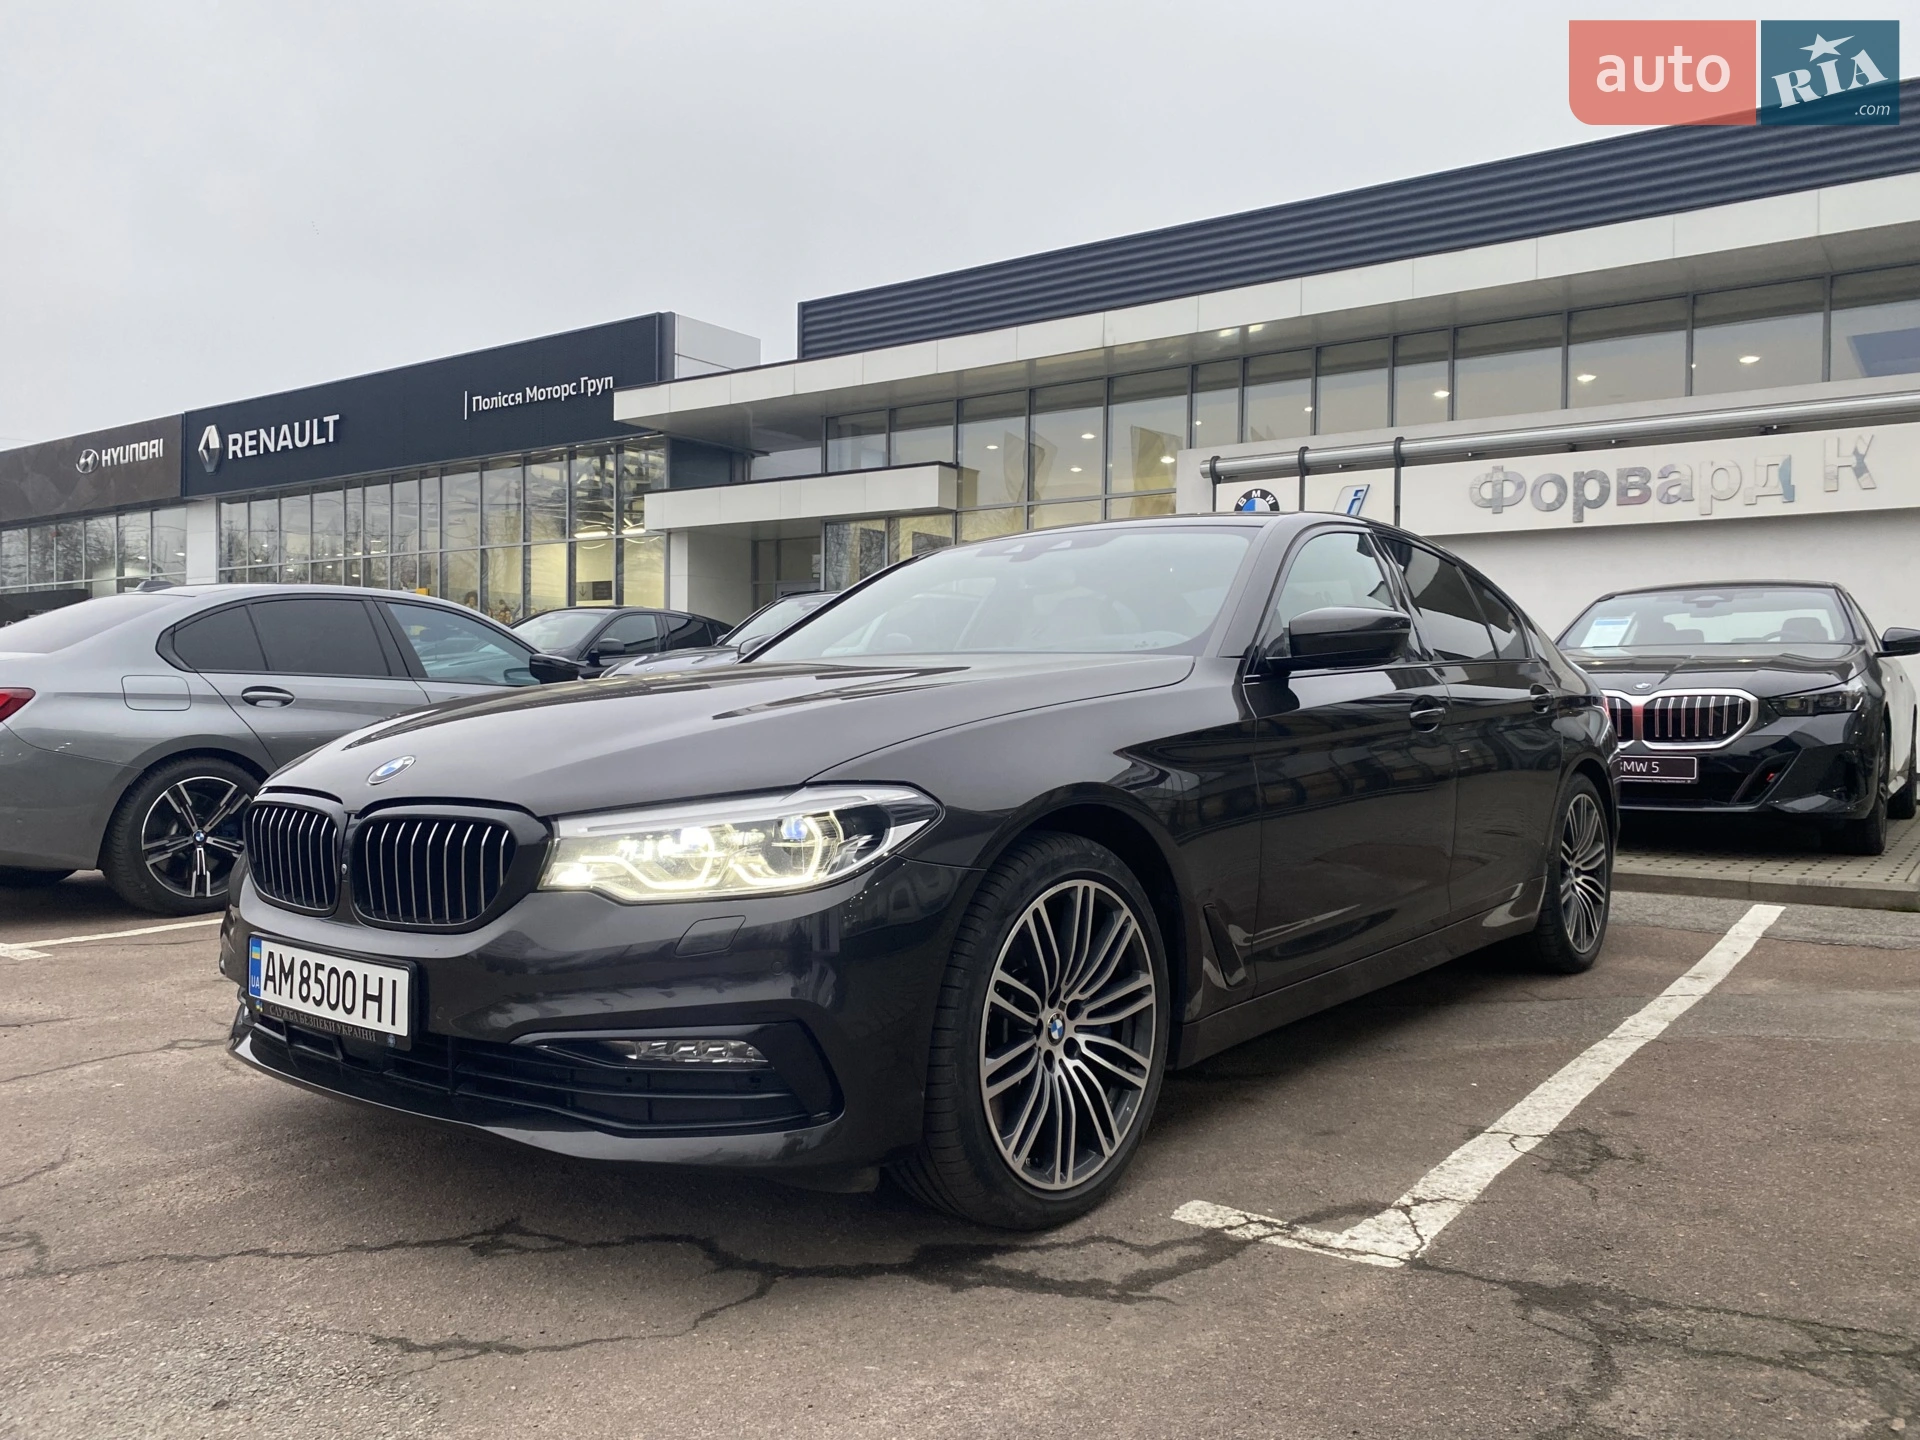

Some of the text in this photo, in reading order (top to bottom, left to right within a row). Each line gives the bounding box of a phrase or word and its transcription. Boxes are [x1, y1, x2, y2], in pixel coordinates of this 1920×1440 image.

[472, 376, 614, 412] Полісся Моторс Груп
[101, 438, 164, 468] HYUNDAI
[228, 414, 340, 459] RENAULT
[1237, 490, 1276, 506] BMW
[1469, 454, 1796, 523] Форвард
[1651, 761, 1660, 773] 5
[251, 975, 260, 989] UA
[269, 1005, 377, 1042] СЛУЖБА БЕЗПЕКИ УКРАЇНИ
